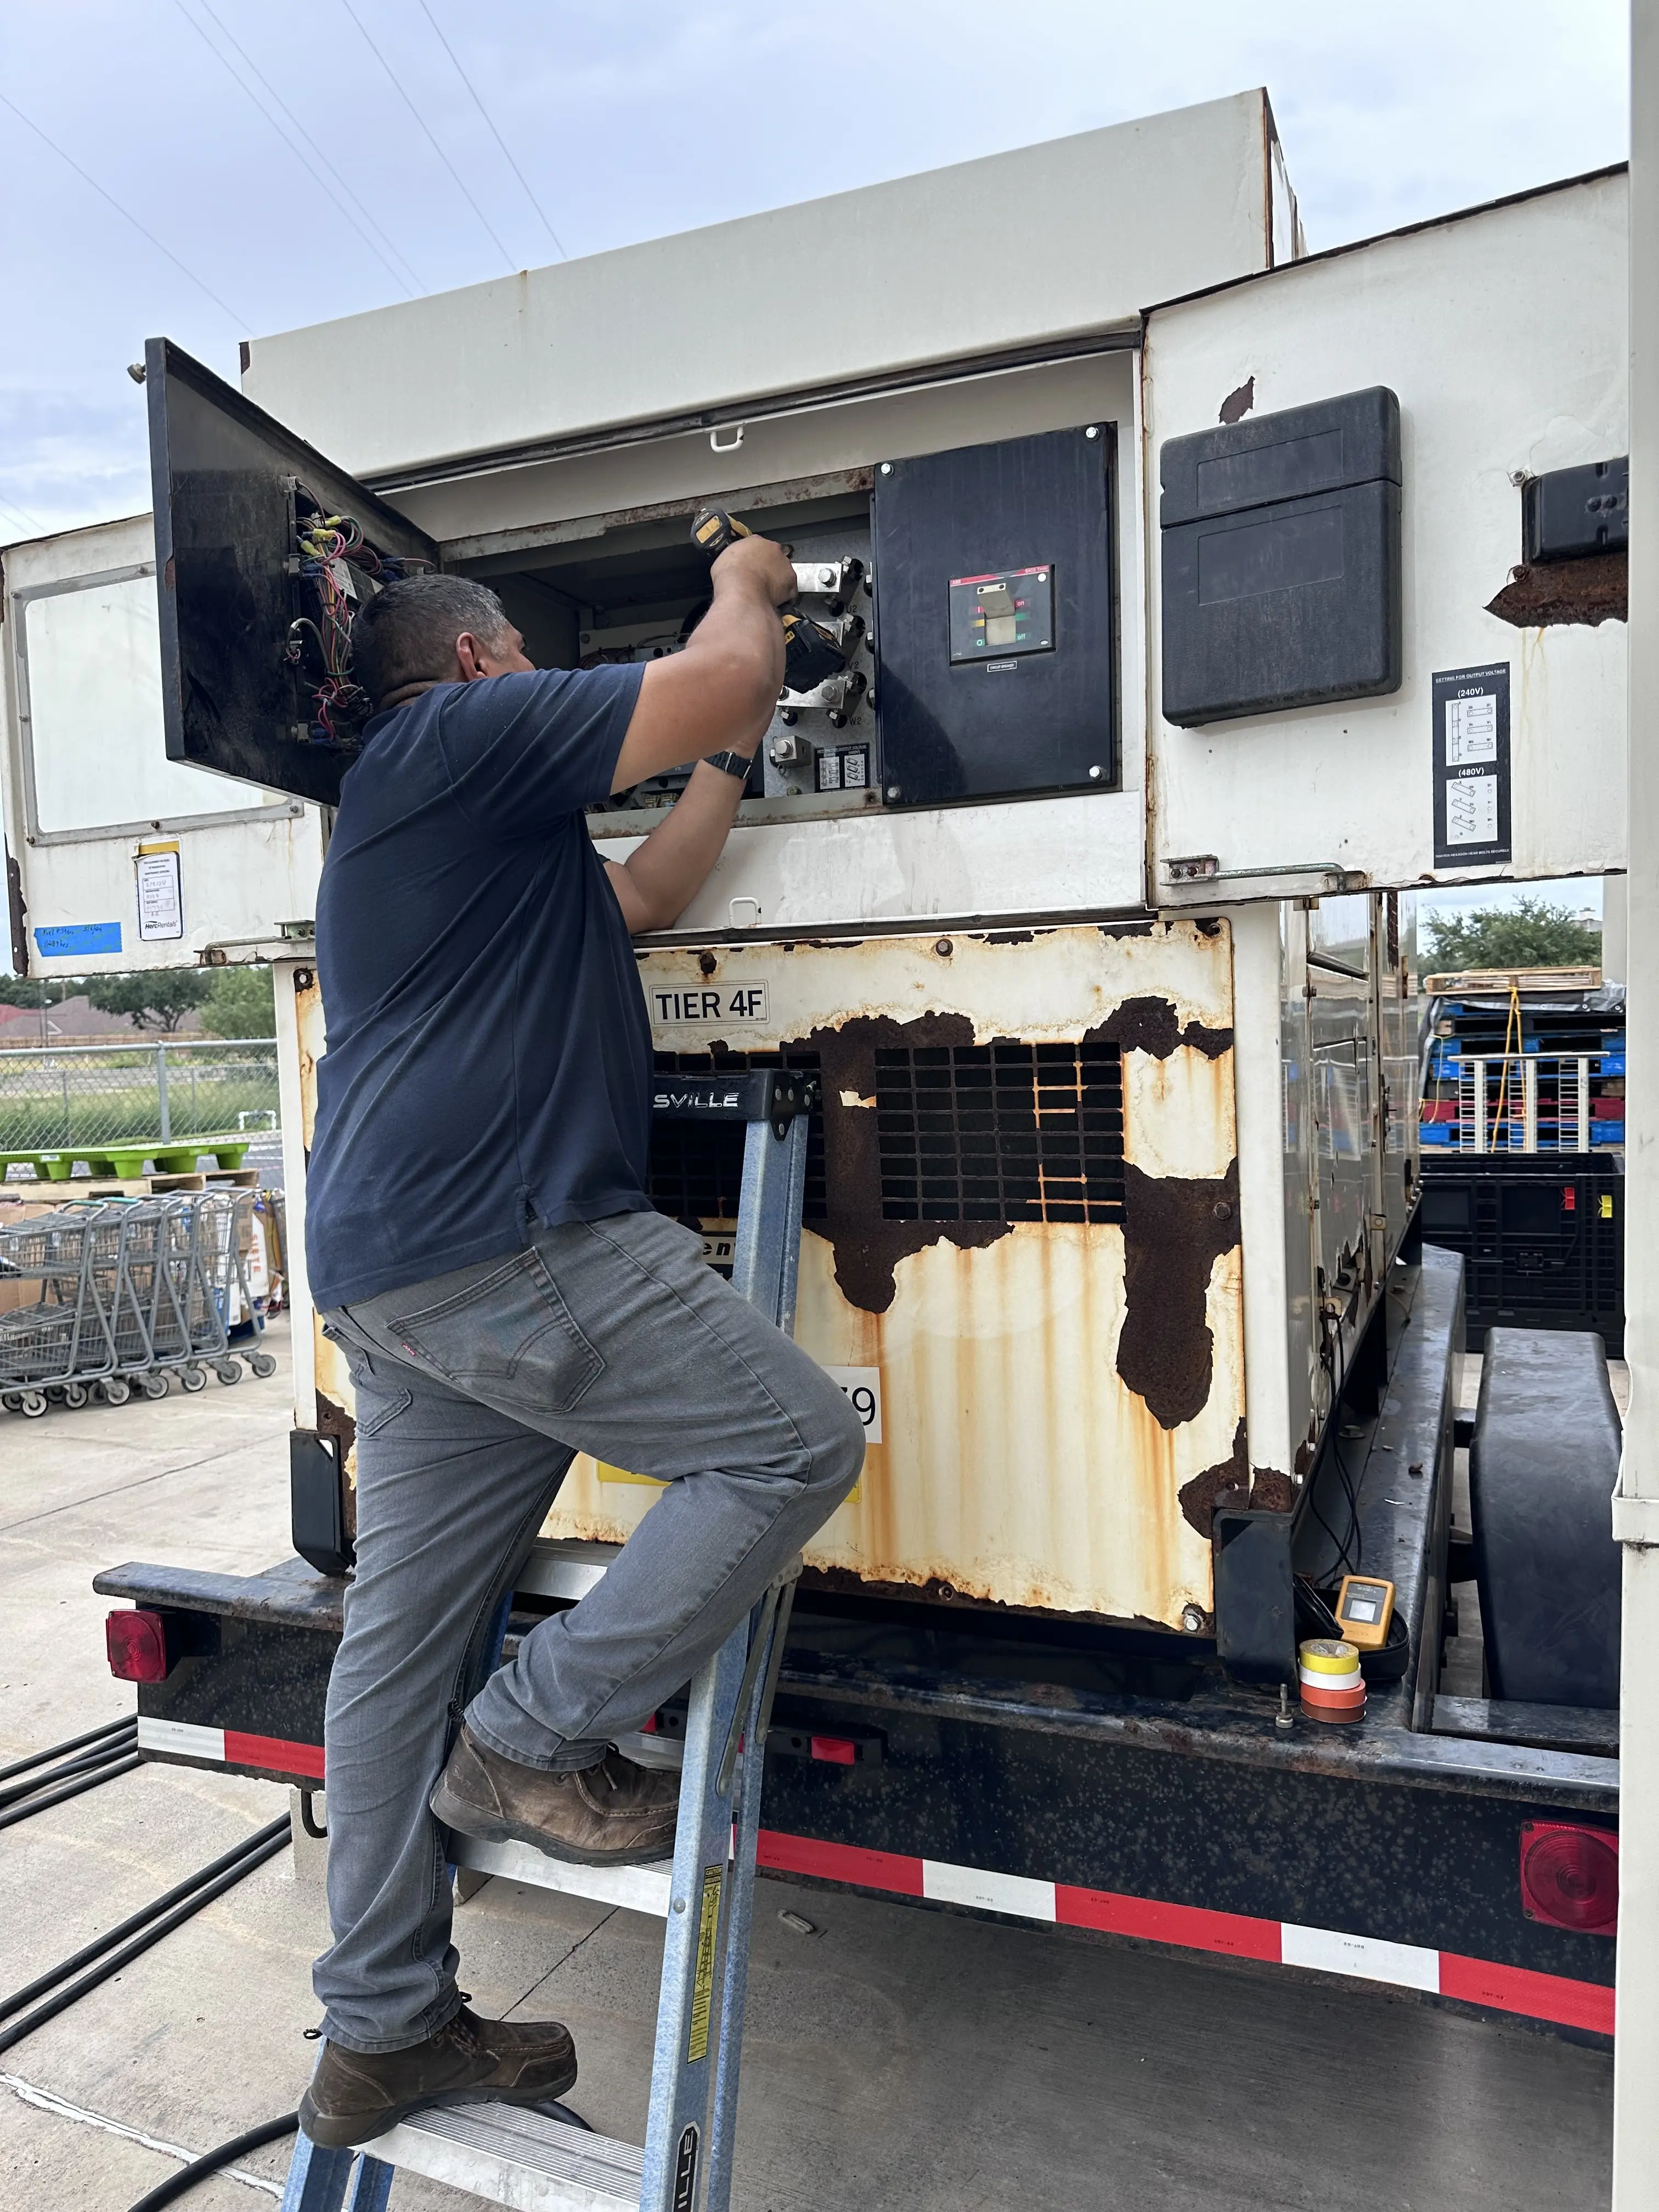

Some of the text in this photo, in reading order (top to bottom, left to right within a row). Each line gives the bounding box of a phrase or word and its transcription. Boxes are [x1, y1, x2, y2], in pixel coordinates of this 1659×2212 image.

[1458, 687, 1483, 698] (240V)
[849, 717, 861, 725] W2
[1458, 767, 1484, 777] (480V)
[145, 921, 176, 929] HercRentals
[656, 990, 763, 1019] TIER 4F
[653, 1092, 739, 1108] SVILLE
[840, 1386, 876, 1426] 9
[706, 1867, 721, 1876] CAUTION
